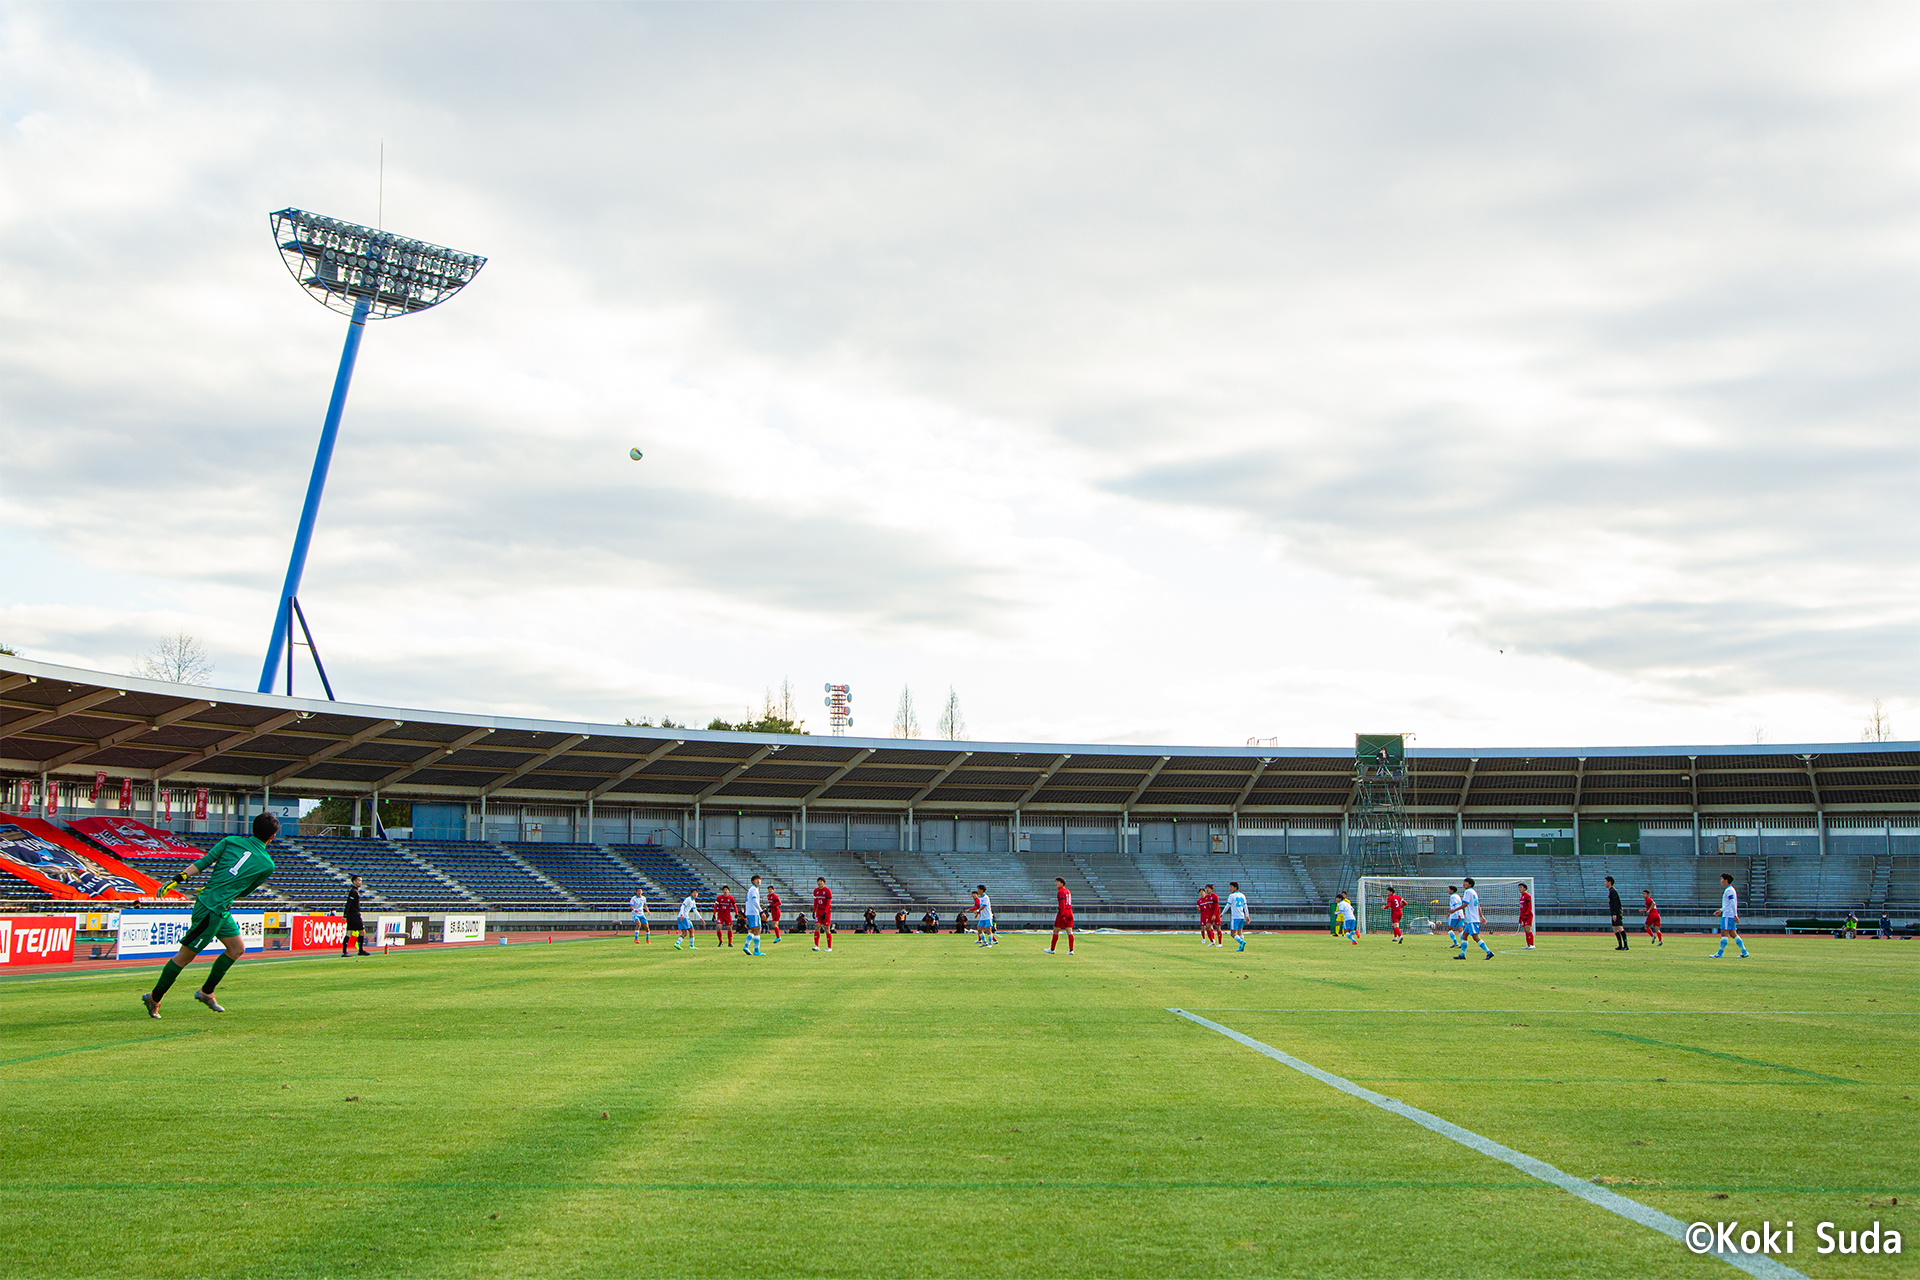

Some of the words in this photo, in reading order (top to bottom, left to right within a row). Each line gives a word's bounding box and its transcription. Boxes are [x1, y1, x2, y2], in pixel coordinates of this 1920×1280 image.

[282, 806, 289, 817] 2
[1557, 829, 1563, 837] 1
[228, 850, 253, 877] 1
[1394, 898, 1400, 908] 3
[13, 927, 73, 958] TEIJIN
[193, 938, 203, 949] 1
